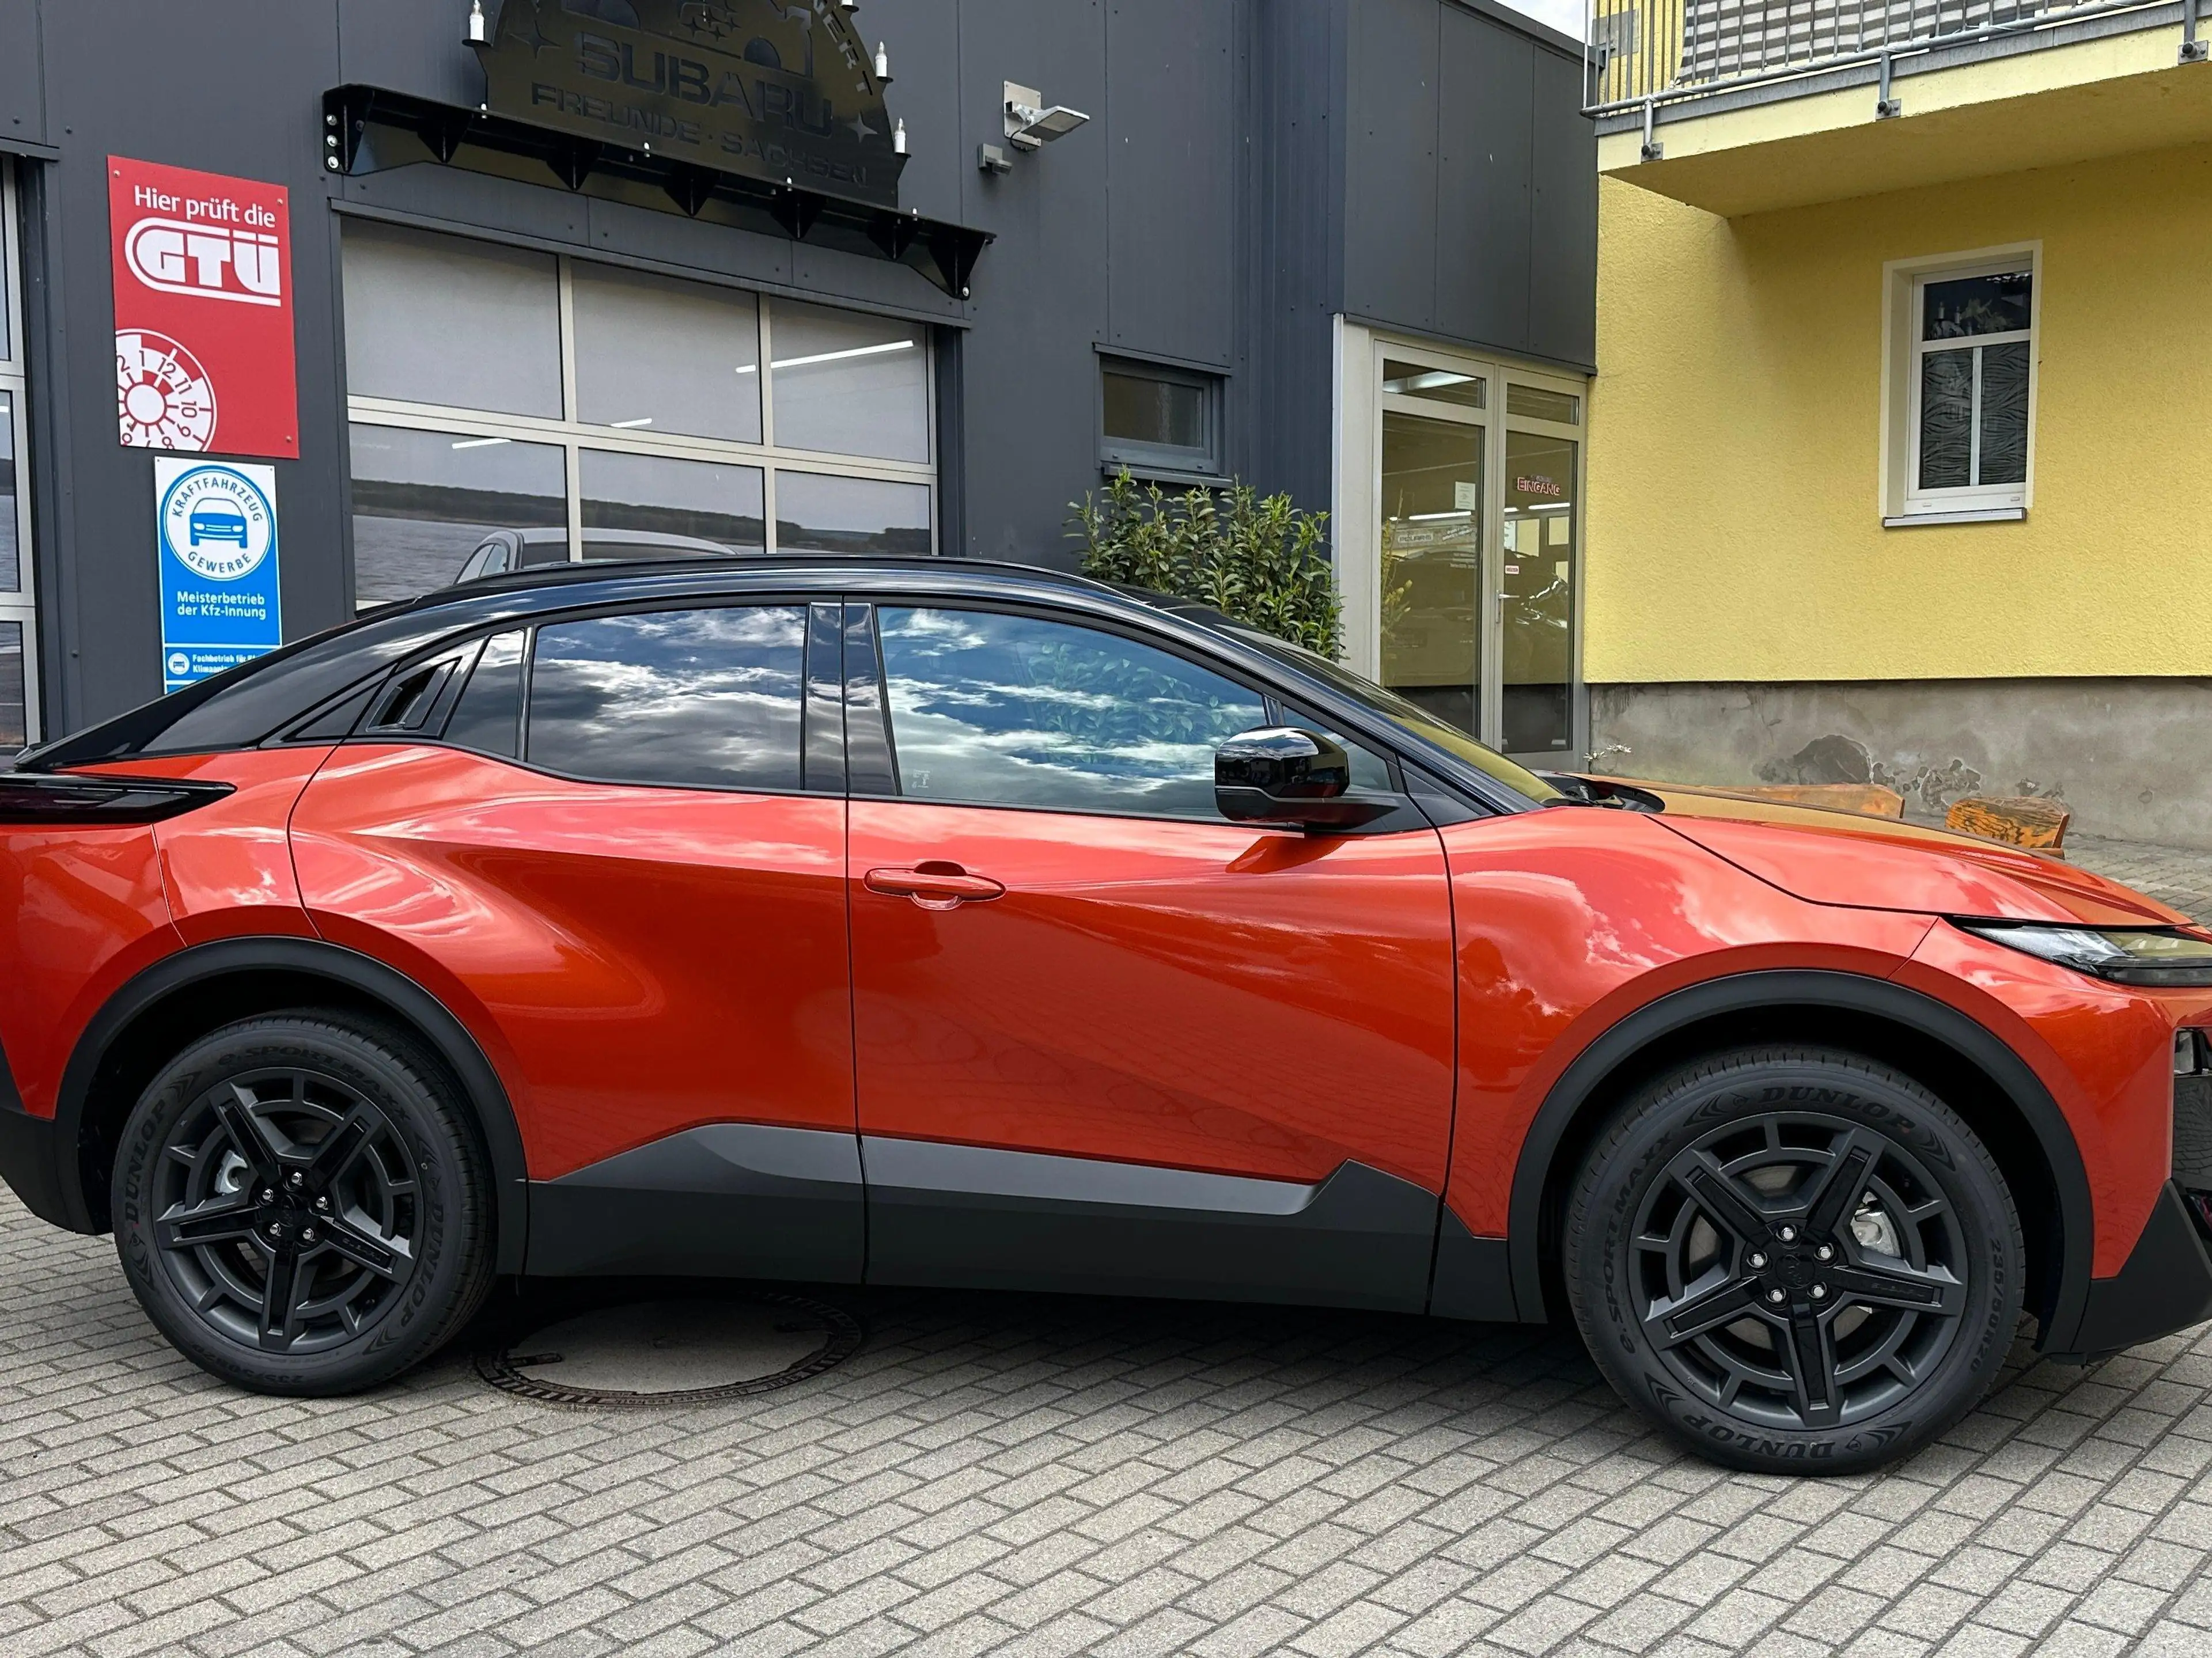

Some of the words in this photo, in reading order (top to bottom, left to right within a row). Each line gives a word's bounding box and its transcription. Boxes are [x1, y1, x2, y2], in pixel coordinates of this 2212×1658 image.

[575, 30, 833, 139] SUBARU
[531, 81, 703, 145] FREUNDE
[720, 131, 868, 185] SACHSEN
[134, 184, 180, 212] Hier
[186, 197, 240, 223] prüft
[244, 204, 276, 228] die
[130, 225, 281, 299] GTÜ
[116, 355, 130, 373] 2
[139, 350, 145, 367] 1
[157, 357, 176, 380] 12
[175, 377, 192, 395] 11
[181, 401, 198, 418] 10
[172, 477, 263, 522] KRAFTFAHRZEUG
[1517, 476, 1560, 496] EINGANG
[188, 551, 251, 574] GEWERBE
[177, 591, 265, 606] Meisterbetrieb
[177, 604, 197, 616] der
[201, 605, 266, 620] Kfz-Innung
[1757, 1086, 1917, 1132] DUNLOP
[125, 1099, 166, 1224] DUNLOP
[1613, 1130, 1672, 1216] MAXX
[400, 1203, 444, 1327] DUNLOP
[1682, 1414, 1836, 1459] DUNLOP
